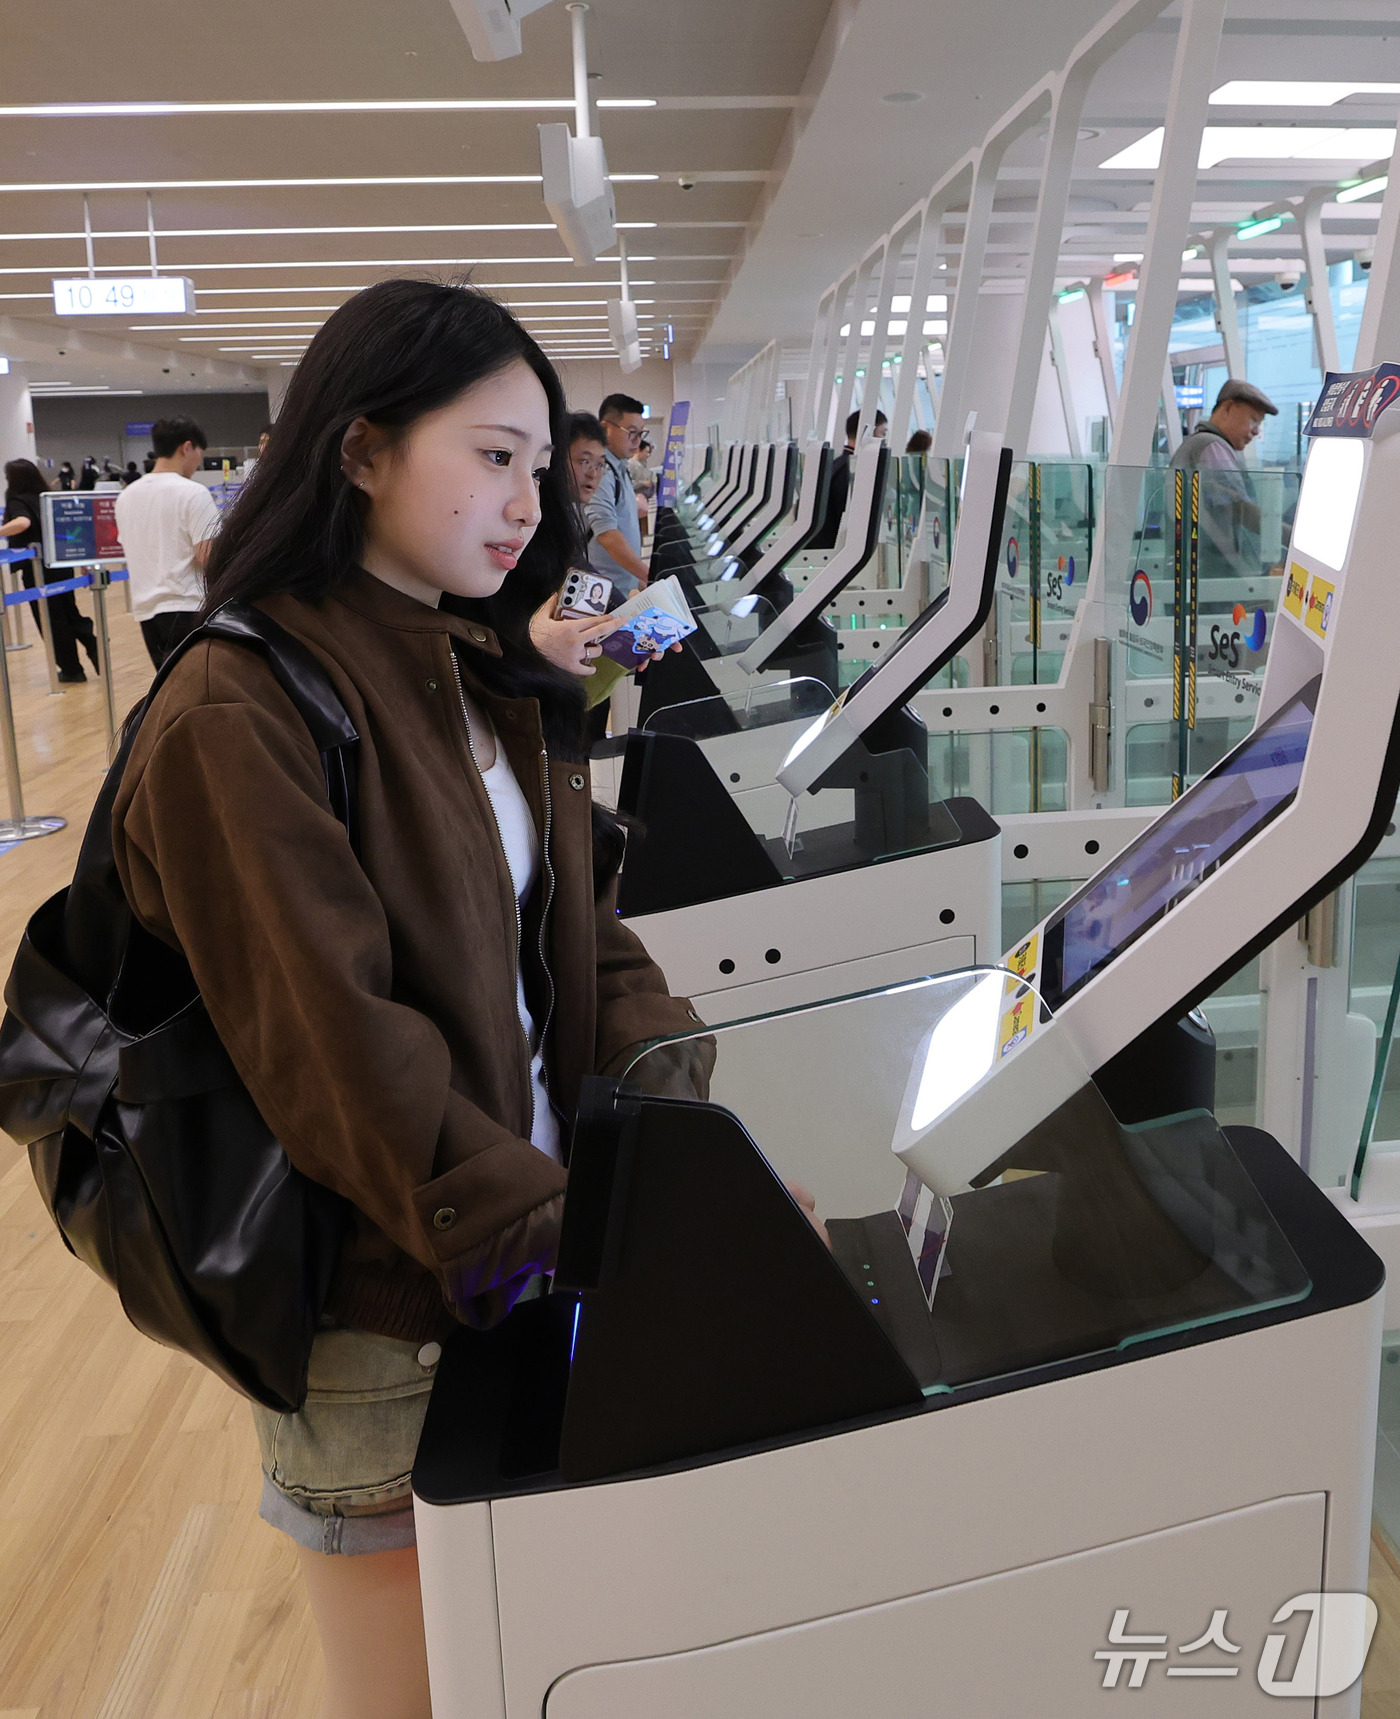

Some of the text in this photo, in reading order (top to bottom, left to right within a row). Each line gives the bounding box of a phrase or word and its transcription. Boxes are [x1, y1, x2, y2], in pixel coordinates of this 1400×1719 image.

[67, 286, 92, 308] 10
[104, 284, 134, 308] 49
[1242, 678, 1261, 696] Servic
